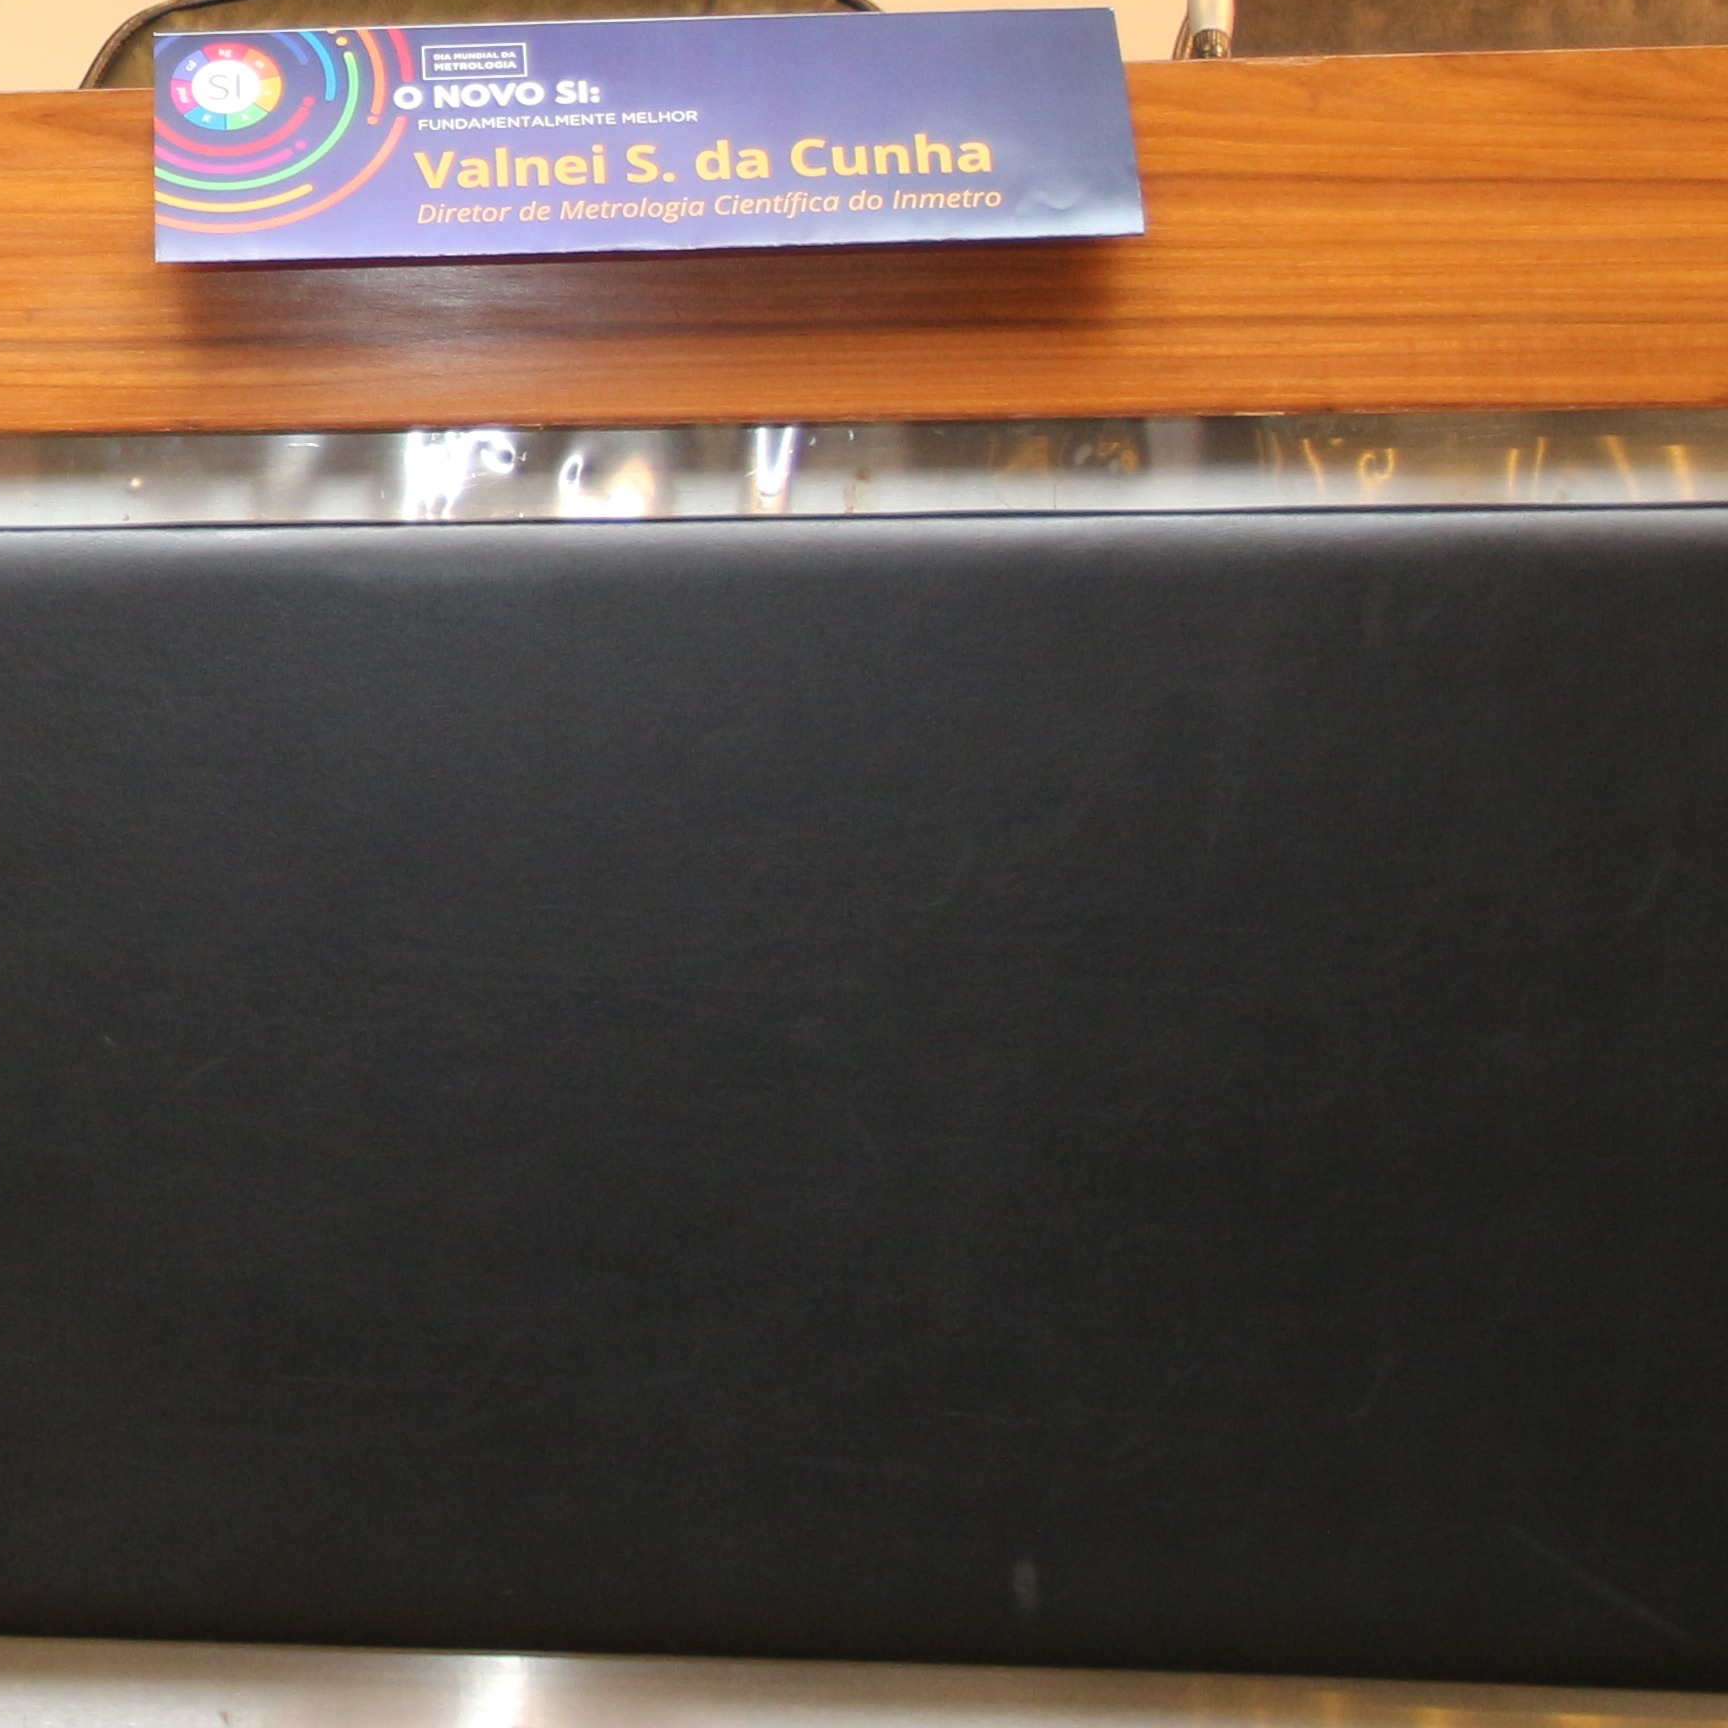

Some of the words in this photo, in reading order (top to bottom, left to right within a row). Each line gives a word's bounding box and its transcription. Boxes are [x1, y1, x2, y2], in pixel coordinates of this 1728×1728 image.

[433, 52, 452, 61] DIA
[453, 52, 499, 61] MUNDIAL
[501, 51, 517, 59] DA
[433, 60, 518, 72] METROLOGIA
[208, 74, 240, 100] SI
[393, 85, 423, 110] O
[433, 82, 545, 109] NOVO
[555, 80, 601, 105] SI:
[418, 112, 617, 131] FUNDAMENTALMENTE
[621, 110, 699, 125] MELHOR
[413, 144, 606, 189] Valnei
[626, 144, 676, 183] S.
[695, 139, 770, 181] da
[790, 133, 993, 177] Cunha
[416, 203, 512, 224] Diretor
[518, 201, 551, 222] de
[560, 197, 705, 223] Metrologia
[714, 191, 840, 219] Científica
[848, 189, 884, 211] do
[893, 188, 1003, 210] Inmetro
